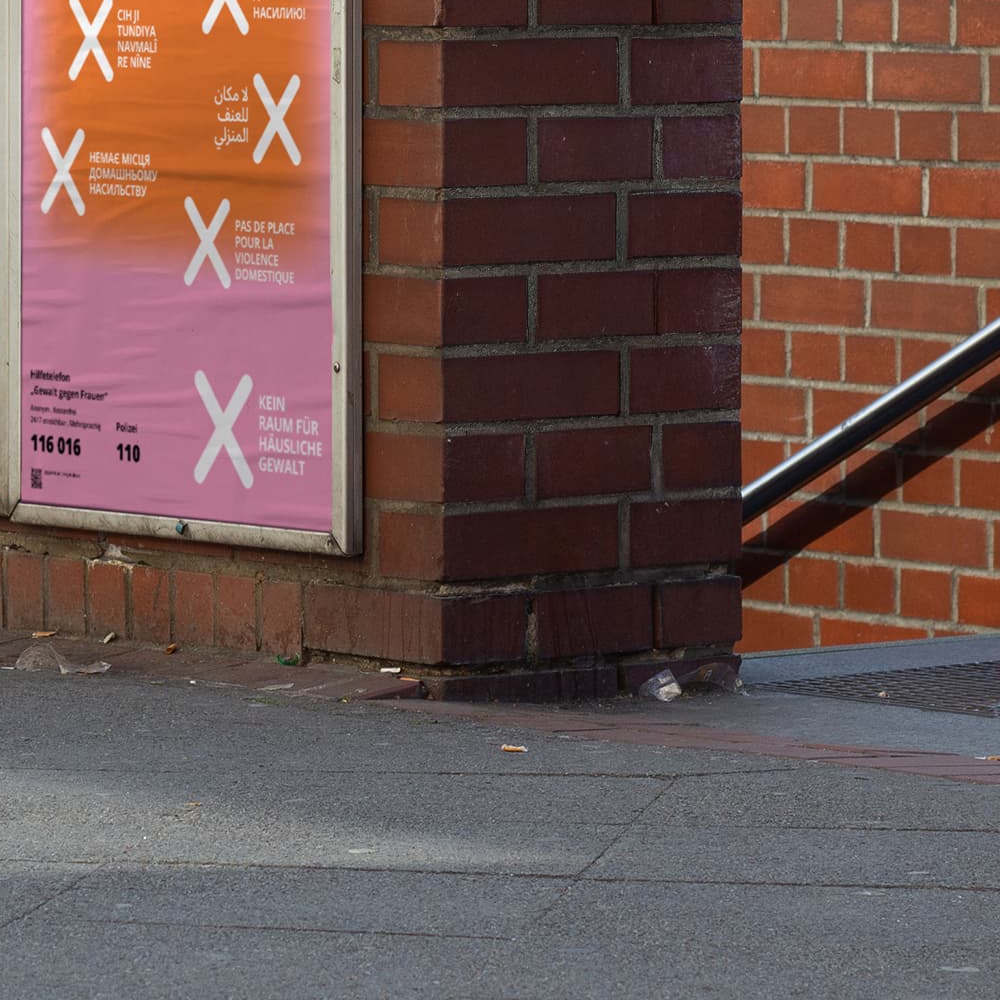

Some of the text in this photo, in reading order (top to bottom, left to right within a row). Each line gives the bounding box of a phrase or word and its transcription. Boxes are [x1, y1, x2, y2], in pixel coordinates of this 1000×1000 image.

[117, 9, 140, 24] CIH JI
[253, 6, 306, 20] НАСИЛИЮ!
[117, 25, 156, 37] TUNDIYA
[117, 56, 128, 68] RE
[214, 85, 239, 105] مكان
[217, 107, 248, 122] للعنف
[89, 167, 158, 182] ДОМАШНЬОМУ
[89, 183, 147, 197] НАСИЛЬСТВУ
[235, 219, 296, 235] PAS DE PLACE
[235, 235, 274, 250] POUR LA
[235, 251, 279, 267] VIOLENCE
[235, 268, 295, 286] DOMESTIQUE
[258, 395, 285, 412] KEIN
[115, 421, 138, 434] Polizei
[258, 415, 319, 436] RAUM FÜR
[31, 434, 81, 456] 116 016
[116, 443, 140, 463] 110
[258, 433, 323, 457] HÄUSLICHE
[258, 456, 306, 477] GEWALT
